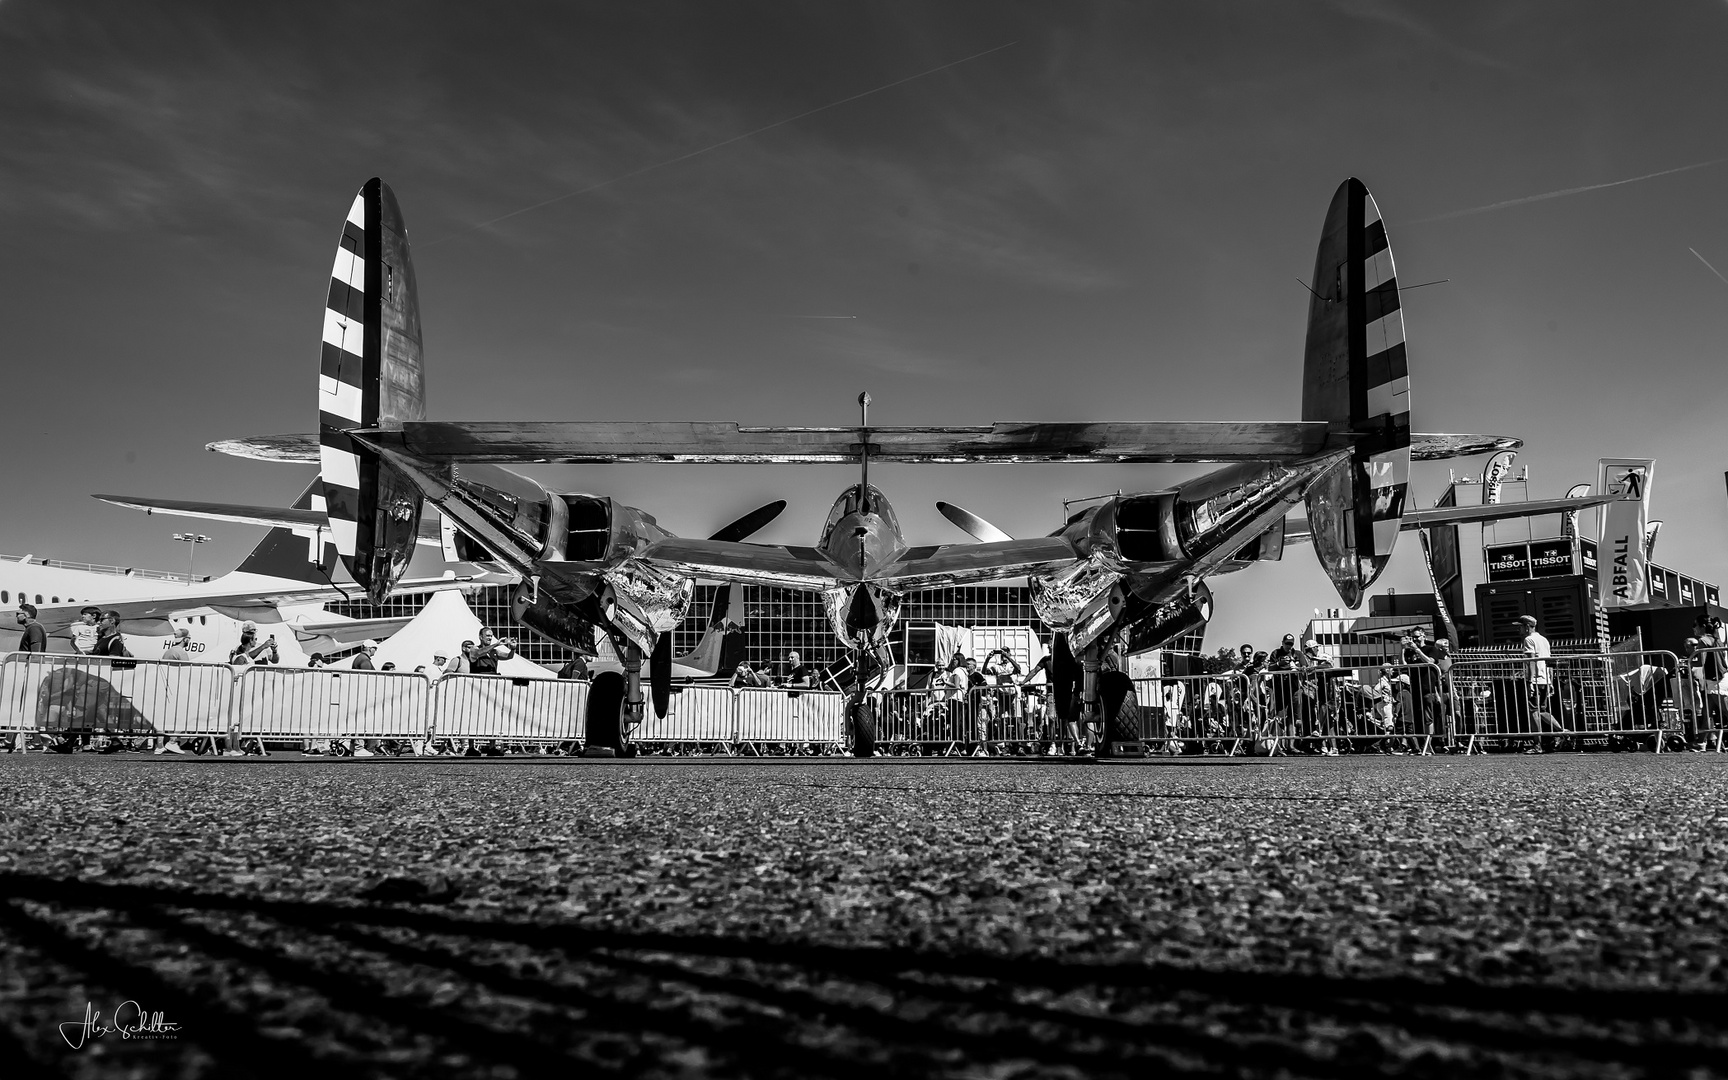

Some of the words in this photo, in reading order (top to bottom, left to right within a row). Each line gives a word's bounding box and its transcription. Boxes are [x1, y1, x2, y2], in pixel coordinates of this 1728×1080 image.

[1488, 461, 1502, 498] TISSOT
[1490, 559, 1527, 570] TISSOT
[1532, 555, 1571, 566] TISSOT
[1612, 535, 1629, 599] ABFALL
[162, 639, 206, 653] HJBD
